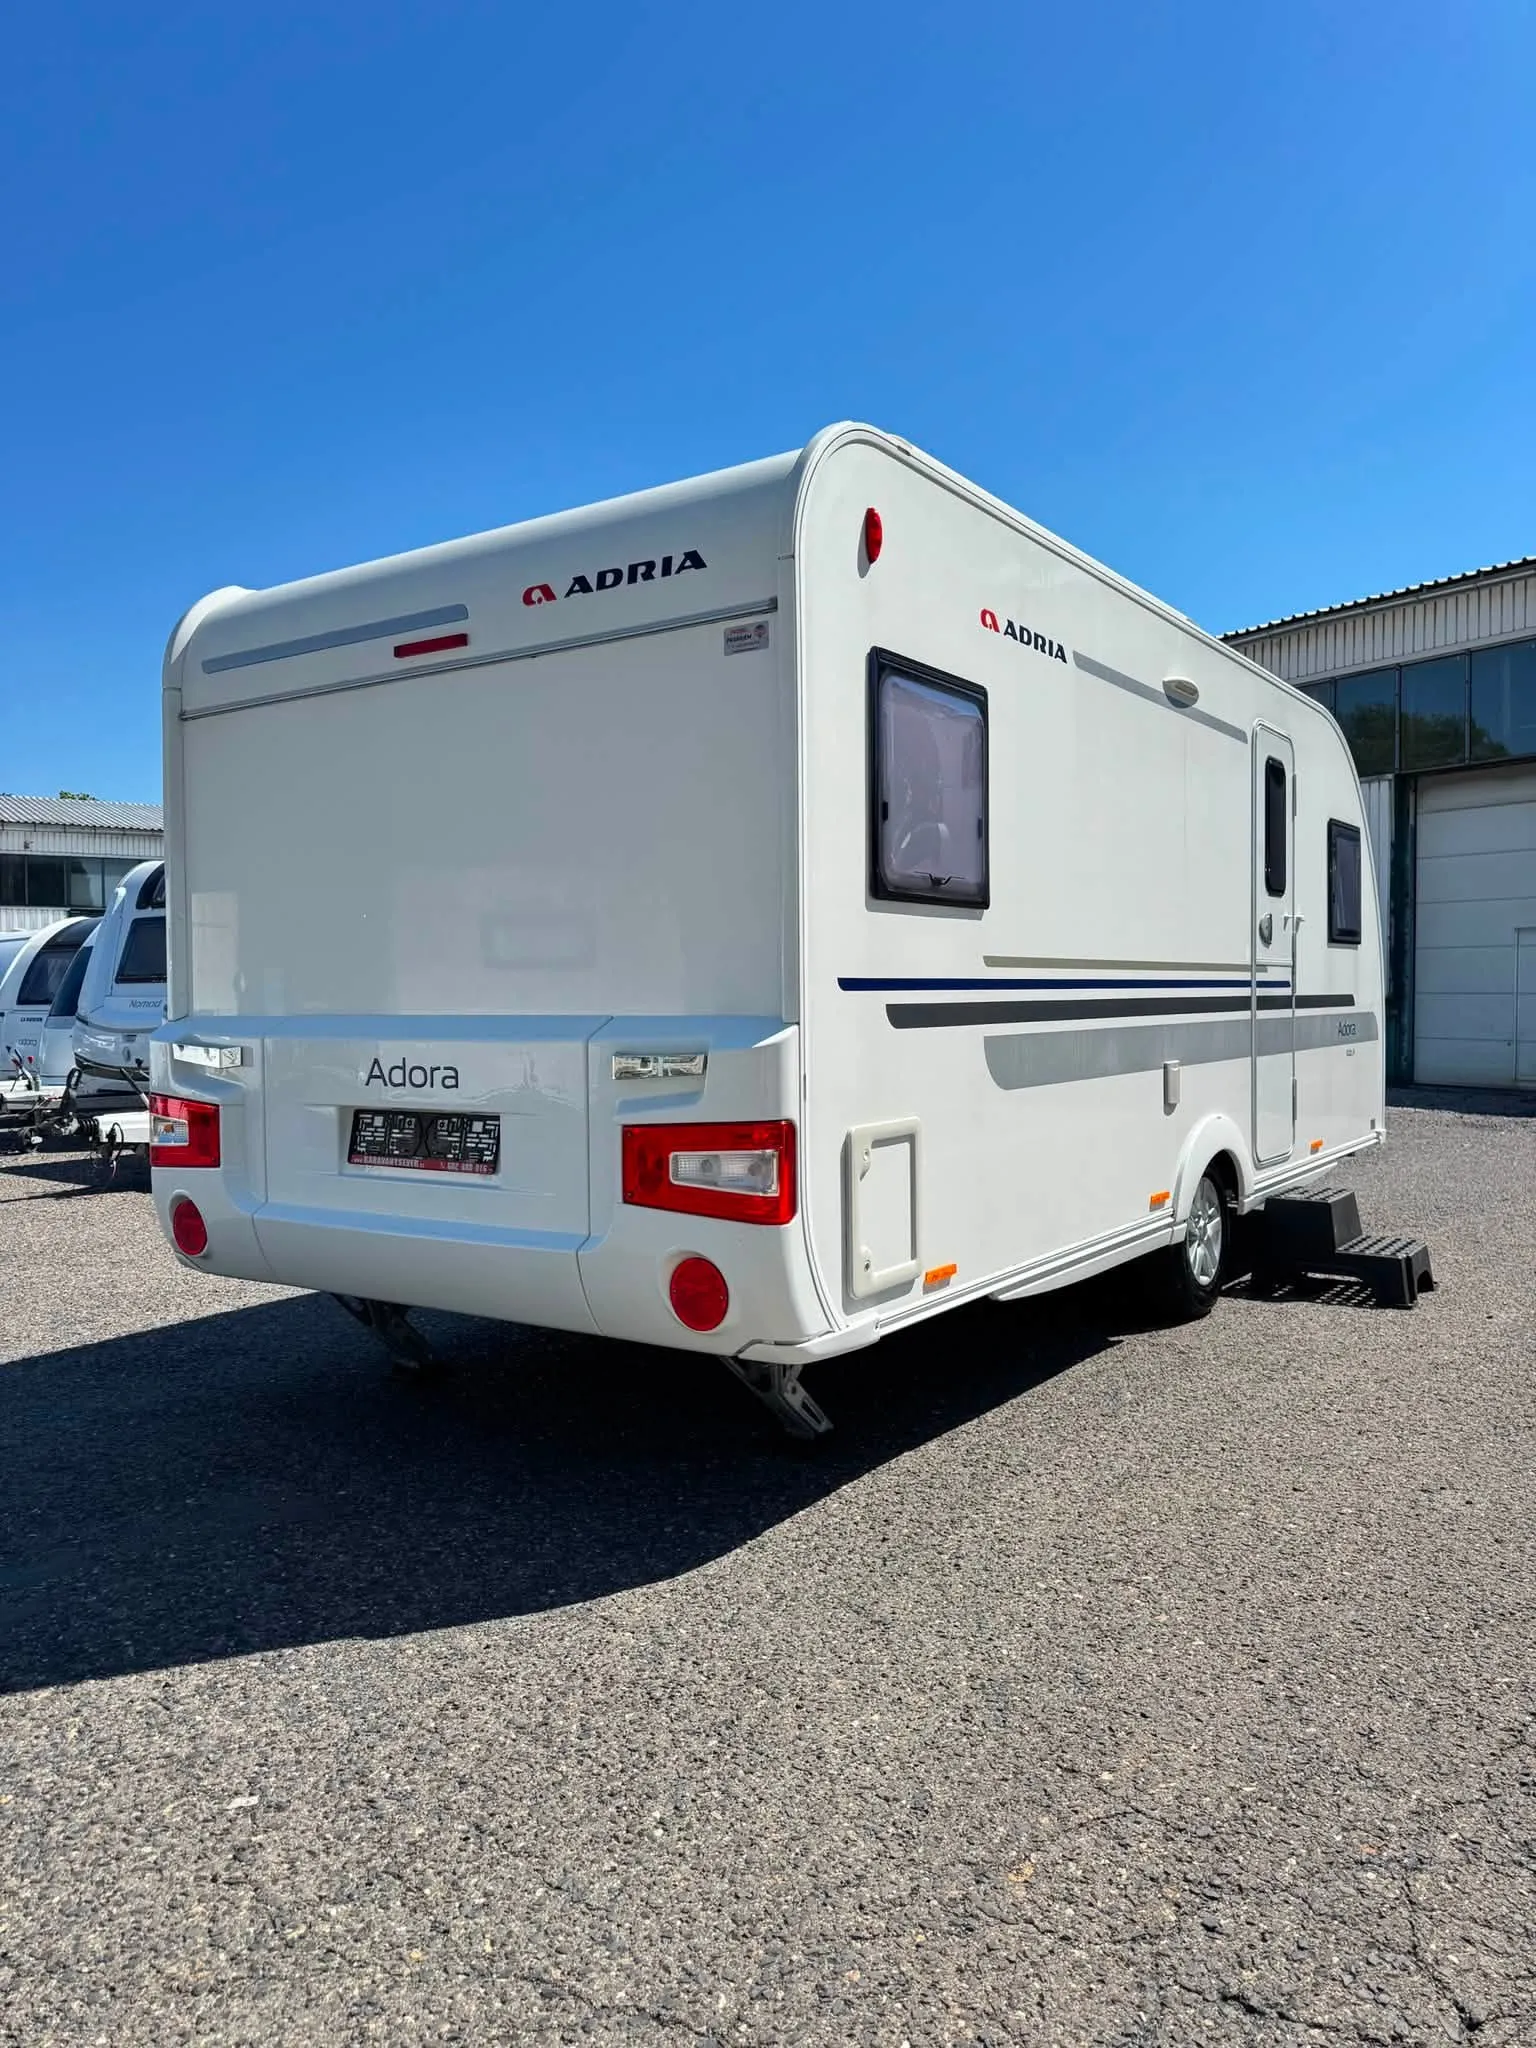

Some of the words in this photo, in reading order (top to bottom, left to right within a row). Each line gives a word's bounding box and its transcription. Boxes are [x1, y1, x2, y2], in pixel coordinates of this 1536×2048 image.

[563, 549, 708, 598] ADRIA
[1003, 619, 1068, 664] ADRIA
[1337, 1020, 1357, 1038] Adora
[364, 1057, 459, 1089] Adora
